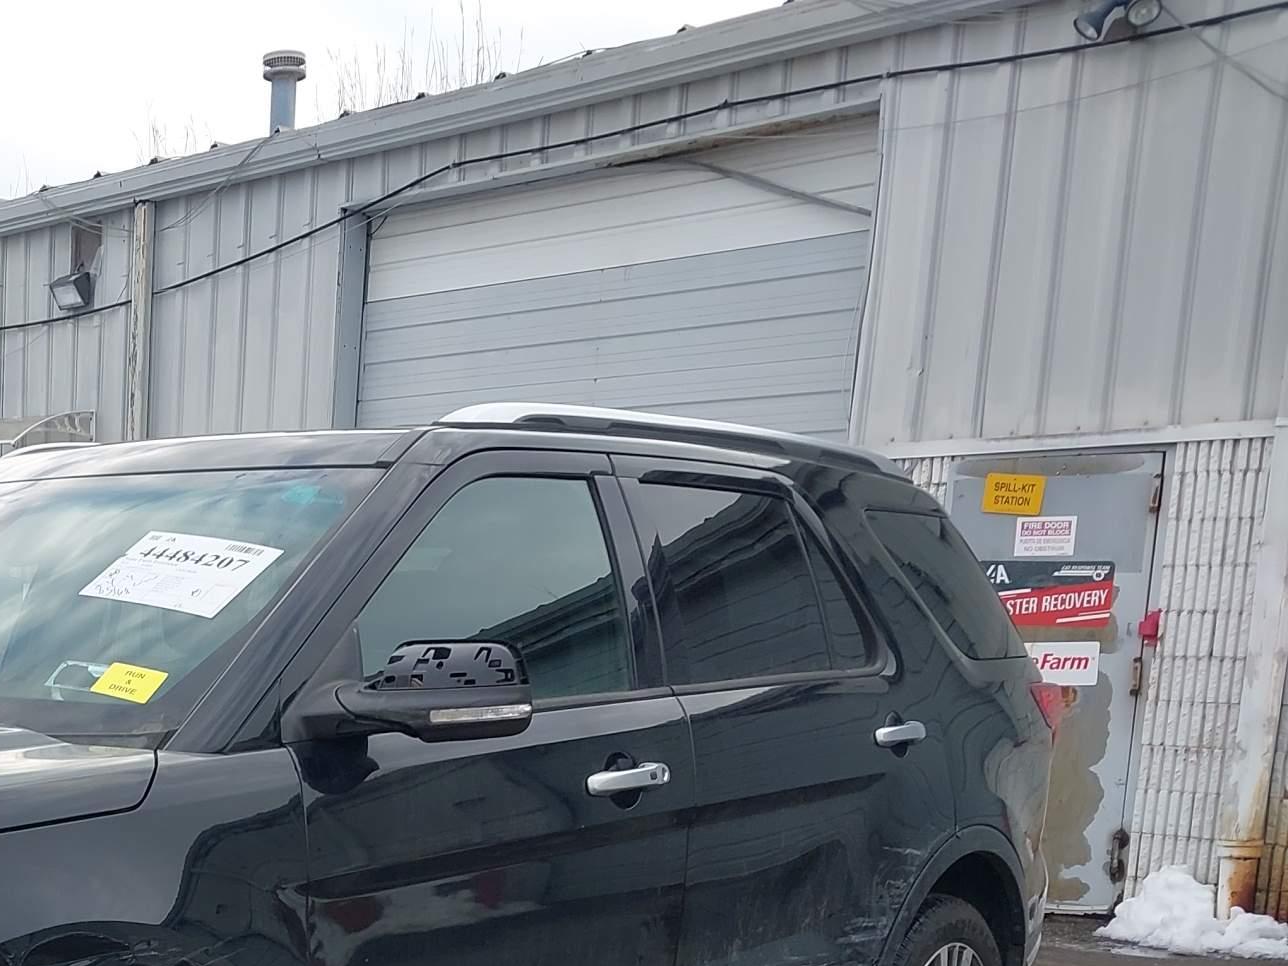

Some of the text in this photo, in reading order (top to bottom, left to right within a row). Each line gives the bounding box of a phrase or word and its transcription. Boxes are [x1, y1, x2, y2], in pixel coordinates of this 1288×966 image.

[994, 482, 1036, 493] SPILL-KIT
[994, 495, 1031, 506] STATION
[1023, 521, 1070, 530] FIRE DOOR
[139, 546, 250, 571] 44484207
[1006, 589, 1109, 615] STER RECOVERY
[1040, 653, 1089, 670] Farm
[124, 670, 146, 680] RUN
[108, 684, 137, 696] DRIVE
